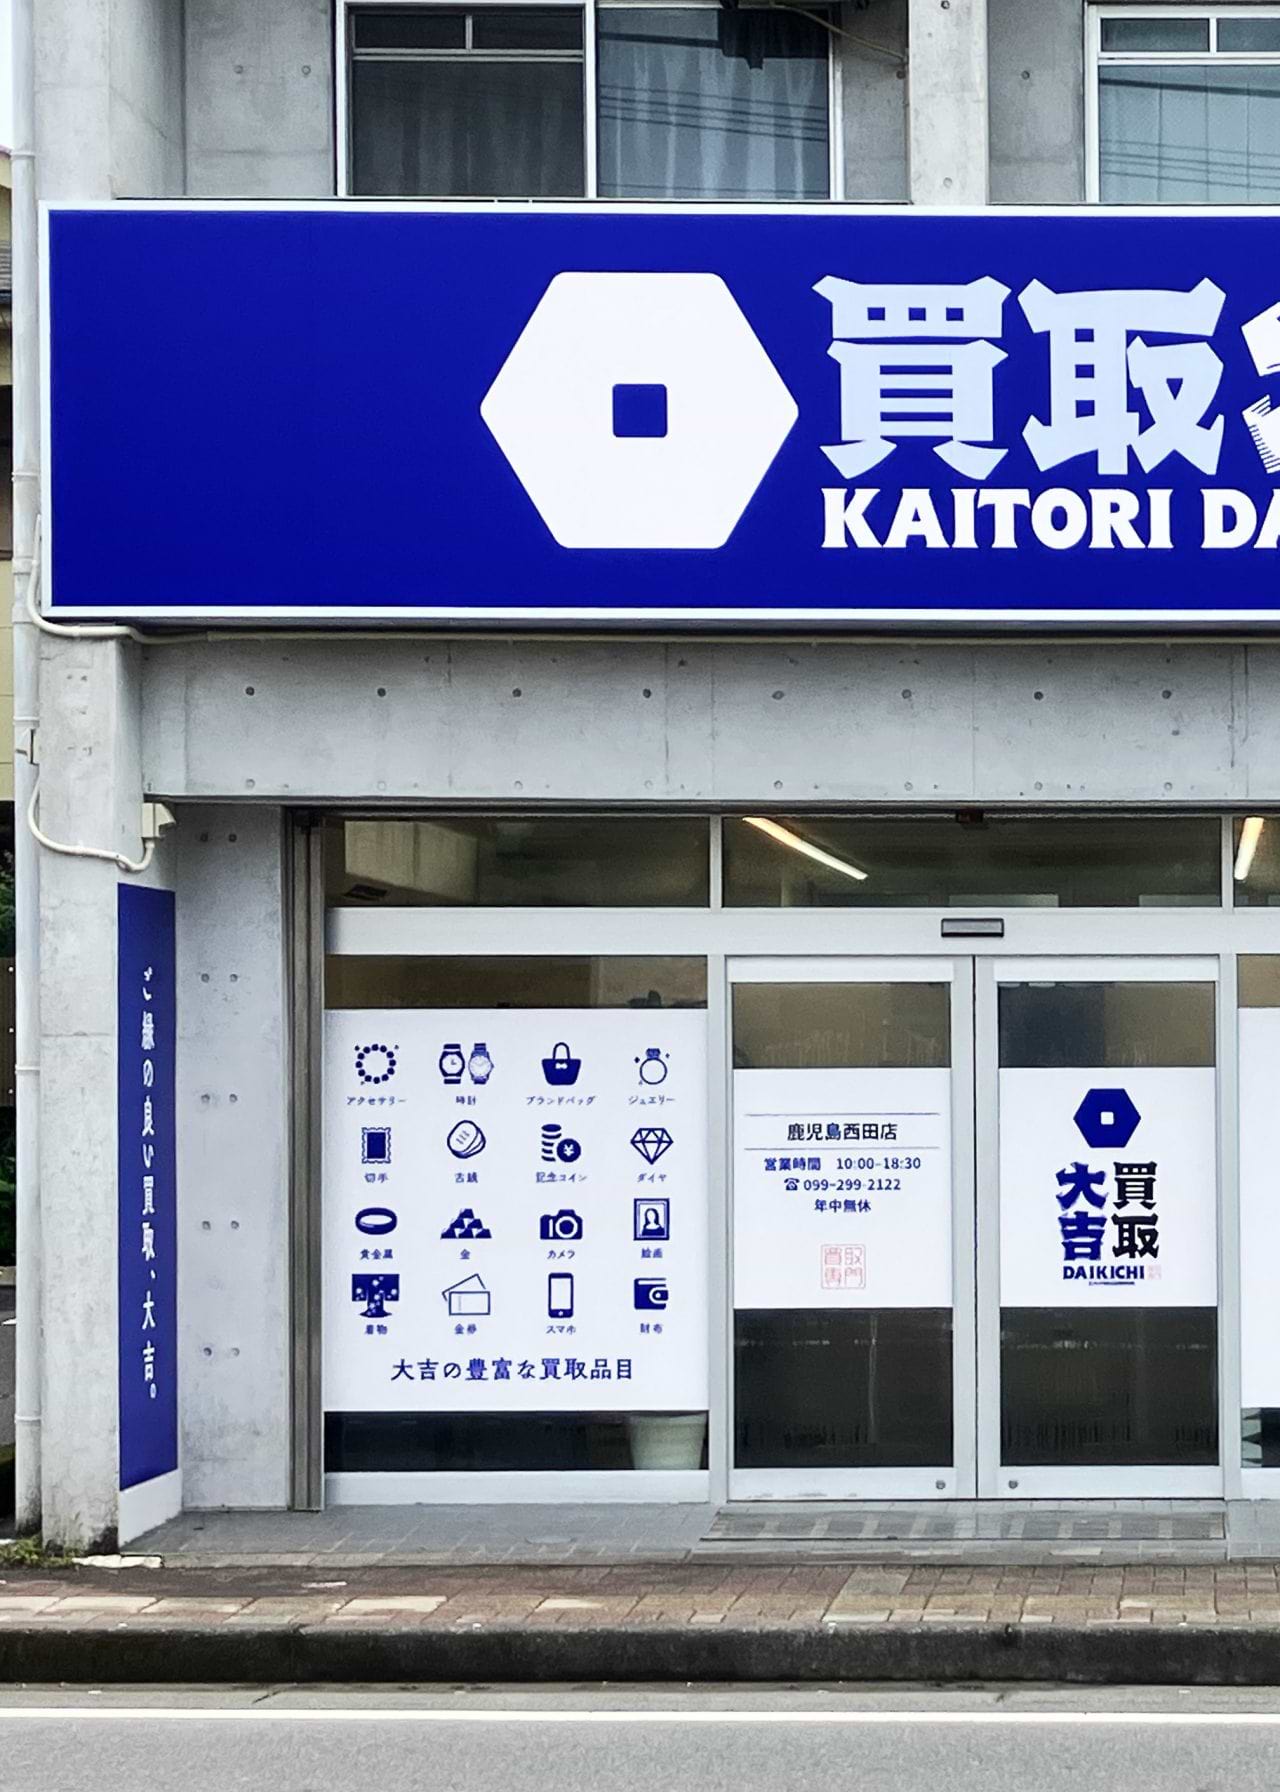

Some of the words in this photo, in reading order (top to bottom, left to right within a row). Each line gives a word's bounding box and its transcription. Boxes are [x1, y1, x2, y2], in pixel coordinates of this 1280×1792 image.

[821, 487, 1174, 549] KAITORI
[346, 1095, 406, 1106] アクセサリー
[628, 1094, 675, 1106] ジュエリー
[786, 1121, 898, 1142] 鹿児島西田店
[763, 1156, 822, 1172] 営業時間
[141, 965, 158, 1400] ご縁の良い買取、大吉。
[363, 1172, 390, 1184] 切手
[535, 1171, 588, 1184] 記念コイン
[637, 1172, 668, 1184] ダイヤ
[813, 1198, 873, 1214] 年中無休
[1055, 1161, 1108, 1261] 大吉
[1110, 1160, 1160, 1259] 買取
[459, 1248, 471, 1261] 金
[546, 1249, 576, 1260] カメラ
[1062, 1265, 1145, 1280] DAIKICHI
[364, 1323, 389, 1336] 着物
[545, 1324, 577, 1336] スマホ
[639, 1322, 664, 1335] 財布
[390, 1356, 633, 1382] 大吉の豊富な買取品目
